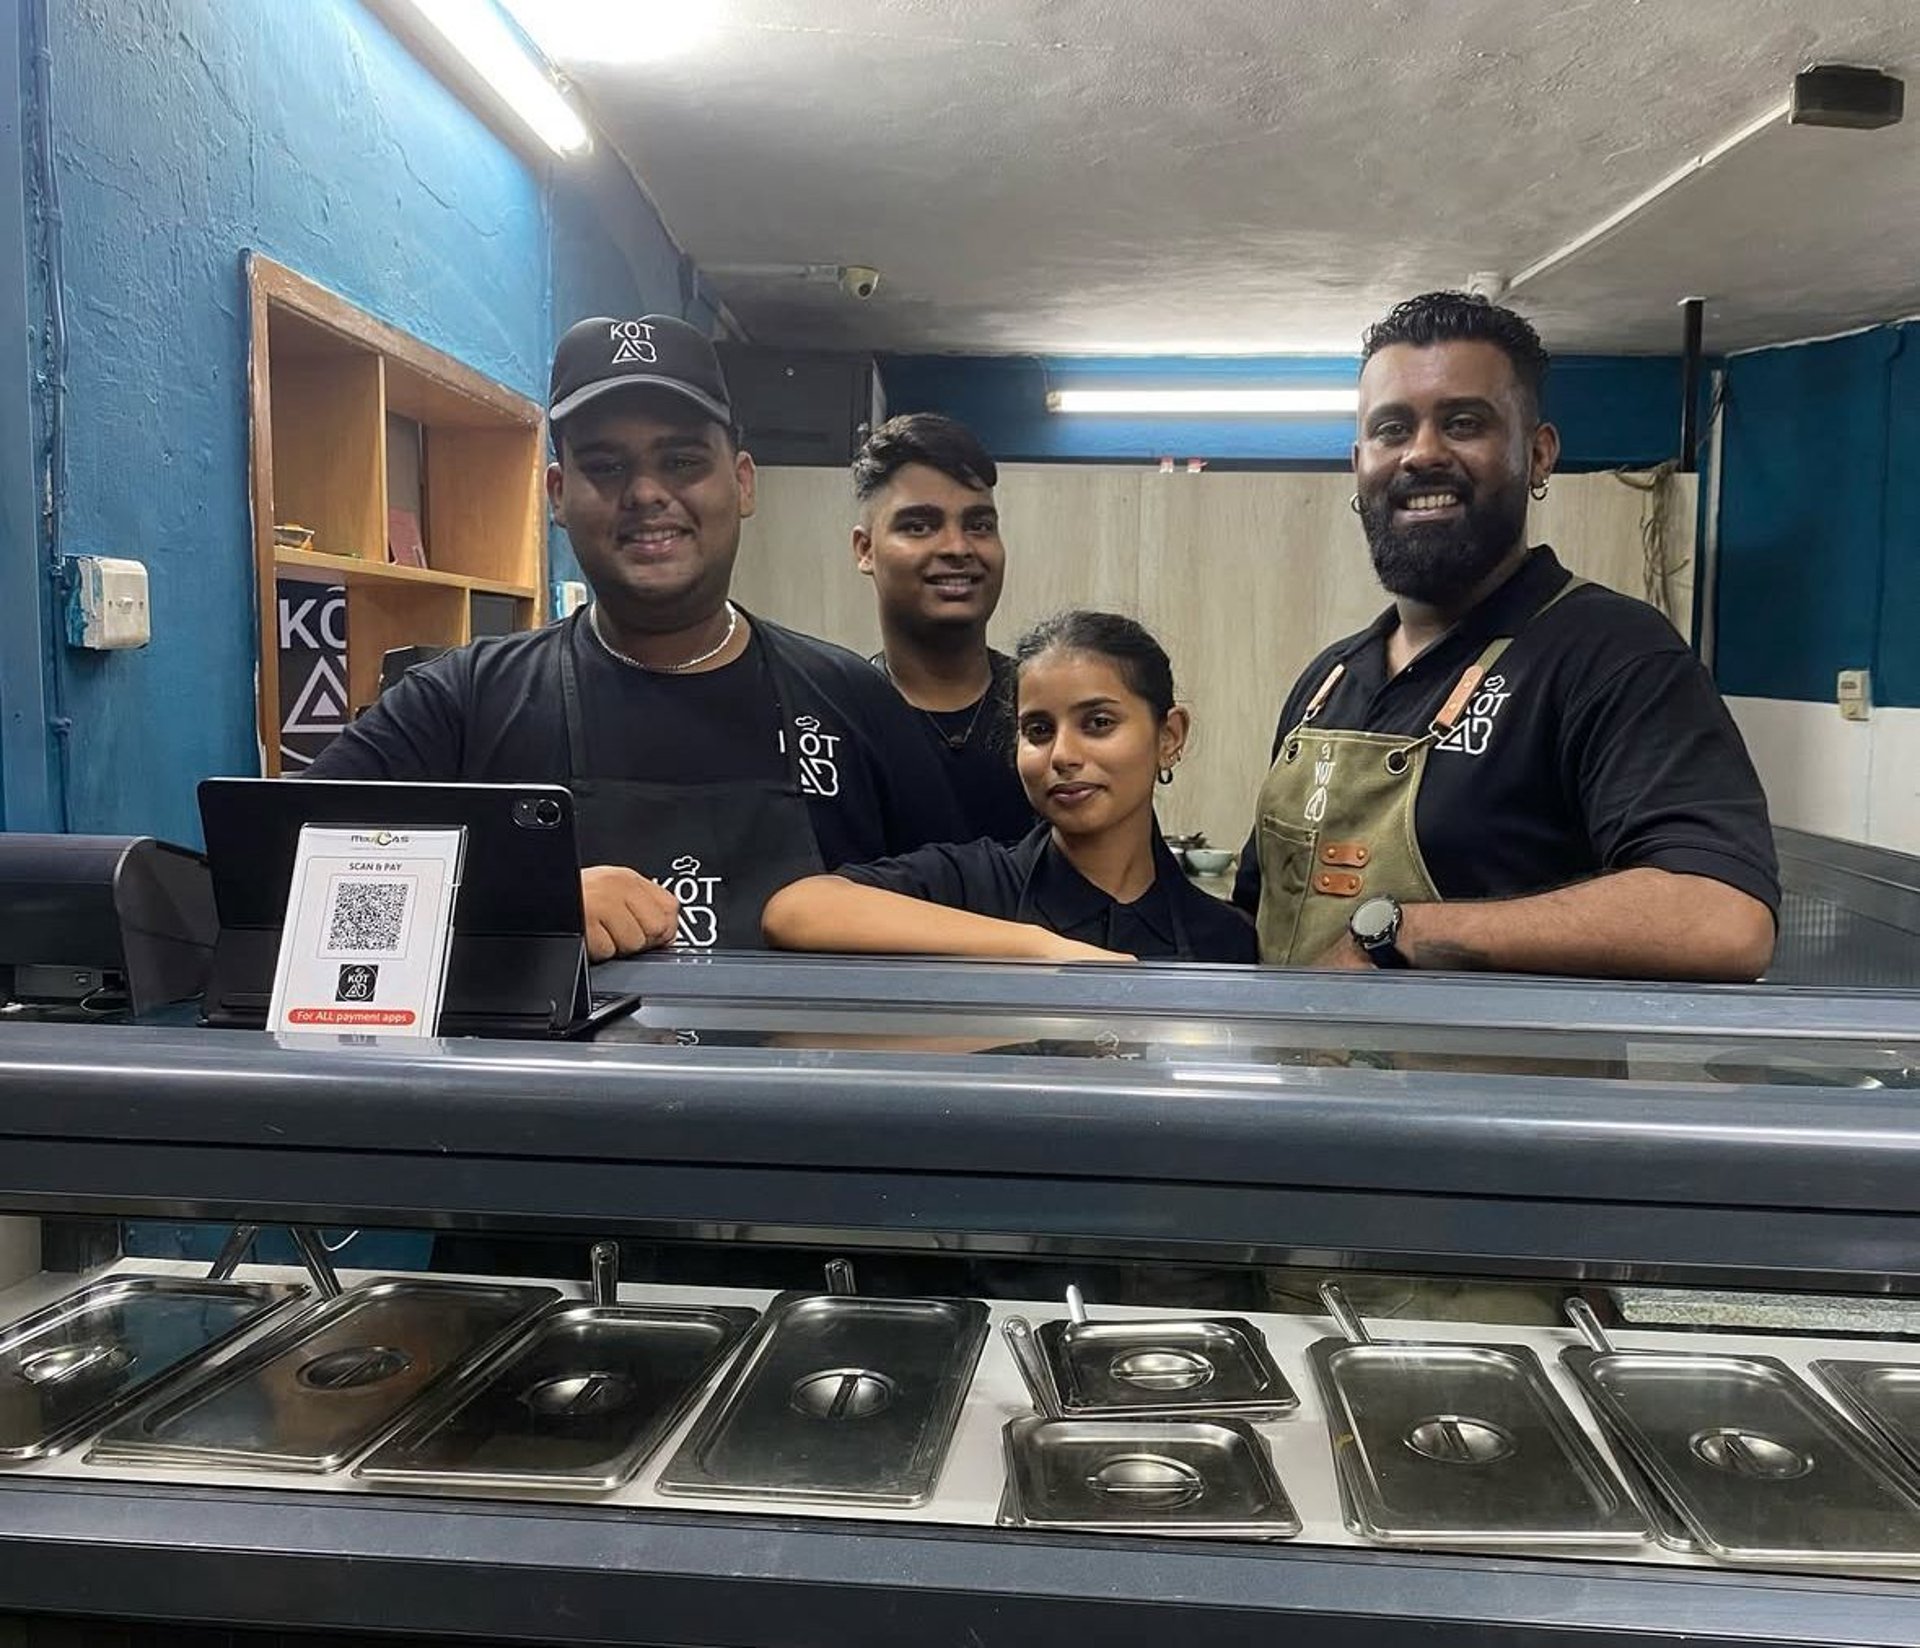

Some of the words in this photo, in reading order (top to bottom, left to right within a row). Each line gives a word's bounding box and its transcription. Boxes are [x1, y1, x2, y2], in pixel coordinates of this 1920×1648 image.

[610, 321, 656, 340] KOT
[778, 729, 841, 759] OT
[348, 862, 374, 871] SCAN
[383, 863, 403, 871] PAY
[346, 973, 371, 984] KOT
[297, 1010, 312, 1020] For
[315, 1010, 334, 1021] ALL
[335, 1012, 380, 1024] payment
[382, 1013, 407, 1024] apps
